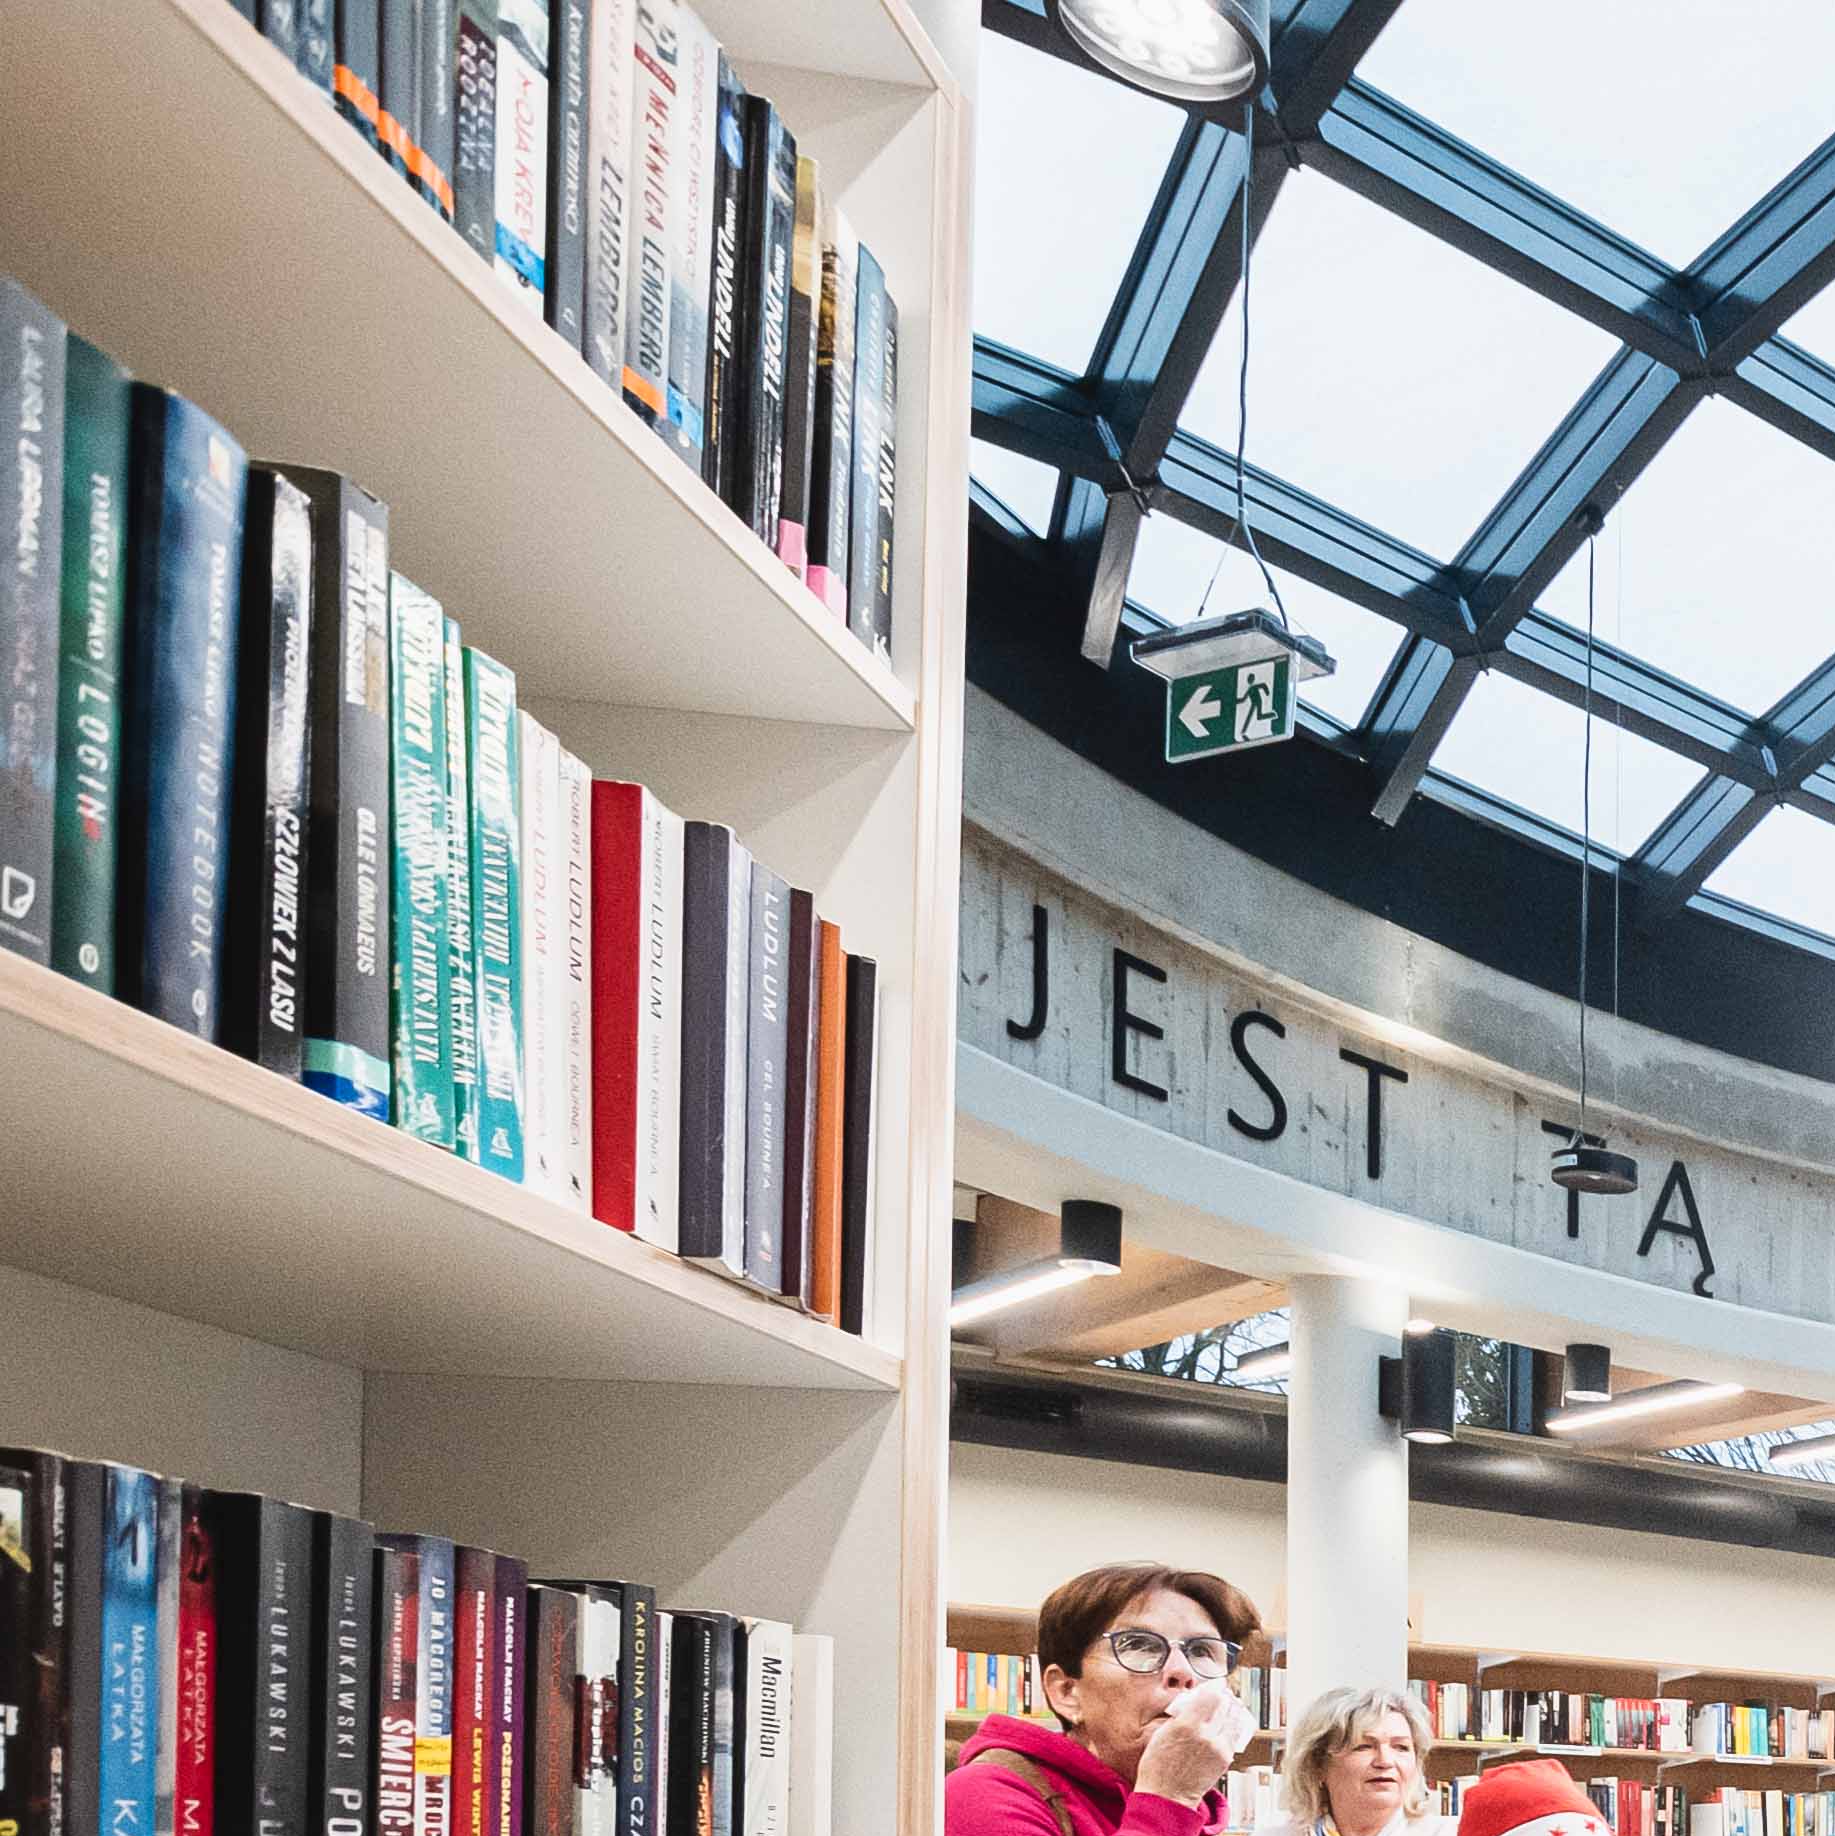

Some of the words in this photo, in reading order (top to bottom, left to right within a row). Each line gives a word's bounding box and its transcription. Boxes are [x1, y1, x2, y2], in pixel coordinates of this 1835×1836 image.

[639, 237, 665, 377] LEMBERG
[712, 227, 736, 358] LINDELL
[762, 275, 783, 400] LINDELL
[833, 361, 851, 446] LINK
[859, 398, 880, 480] LINK
[88, 474, 111, 578] TOMASZ
[878, 430, 894, 521] LINK
[190, 742, 217, 961] NOTEBOOK
[272, 806, 300, 935] CZŁOWIEK
[569, 778, 582, 857] ROBERT
[567, 860, 583, 982] LUDLUM
[649, 902, 664, 1021] LUDLUM
[761, 892, 780, 1023] LUDLUM
[269, 959, 295, 1033] LASU
[1007, 904, 1407, 1179] JEST
[266, 1606, 290, 1754] ŁUKAWSKI
[502, 1596, 515, 1666] MALCOLM
[632, 1601, 648, 1700] KAROLINA
[110, 1642, 129, 1742] ŁATKA
[129, 1624, 146, 1764] MAŁGORZATA
[192, 1630, 209, 1765] MAŁGORZATA
[335, 1619, 358, 1760] ŁUKAWSKI
[501, 1670, 514, 1723] MACKAY
[631, 1706, 646, 1784] MACIOS
[758, 1656, 784, 1759] Macmillan
[378, 1716, 417, 1827] ŚMIERĆ
[469, 1727, 484, 1785] LEWIS
